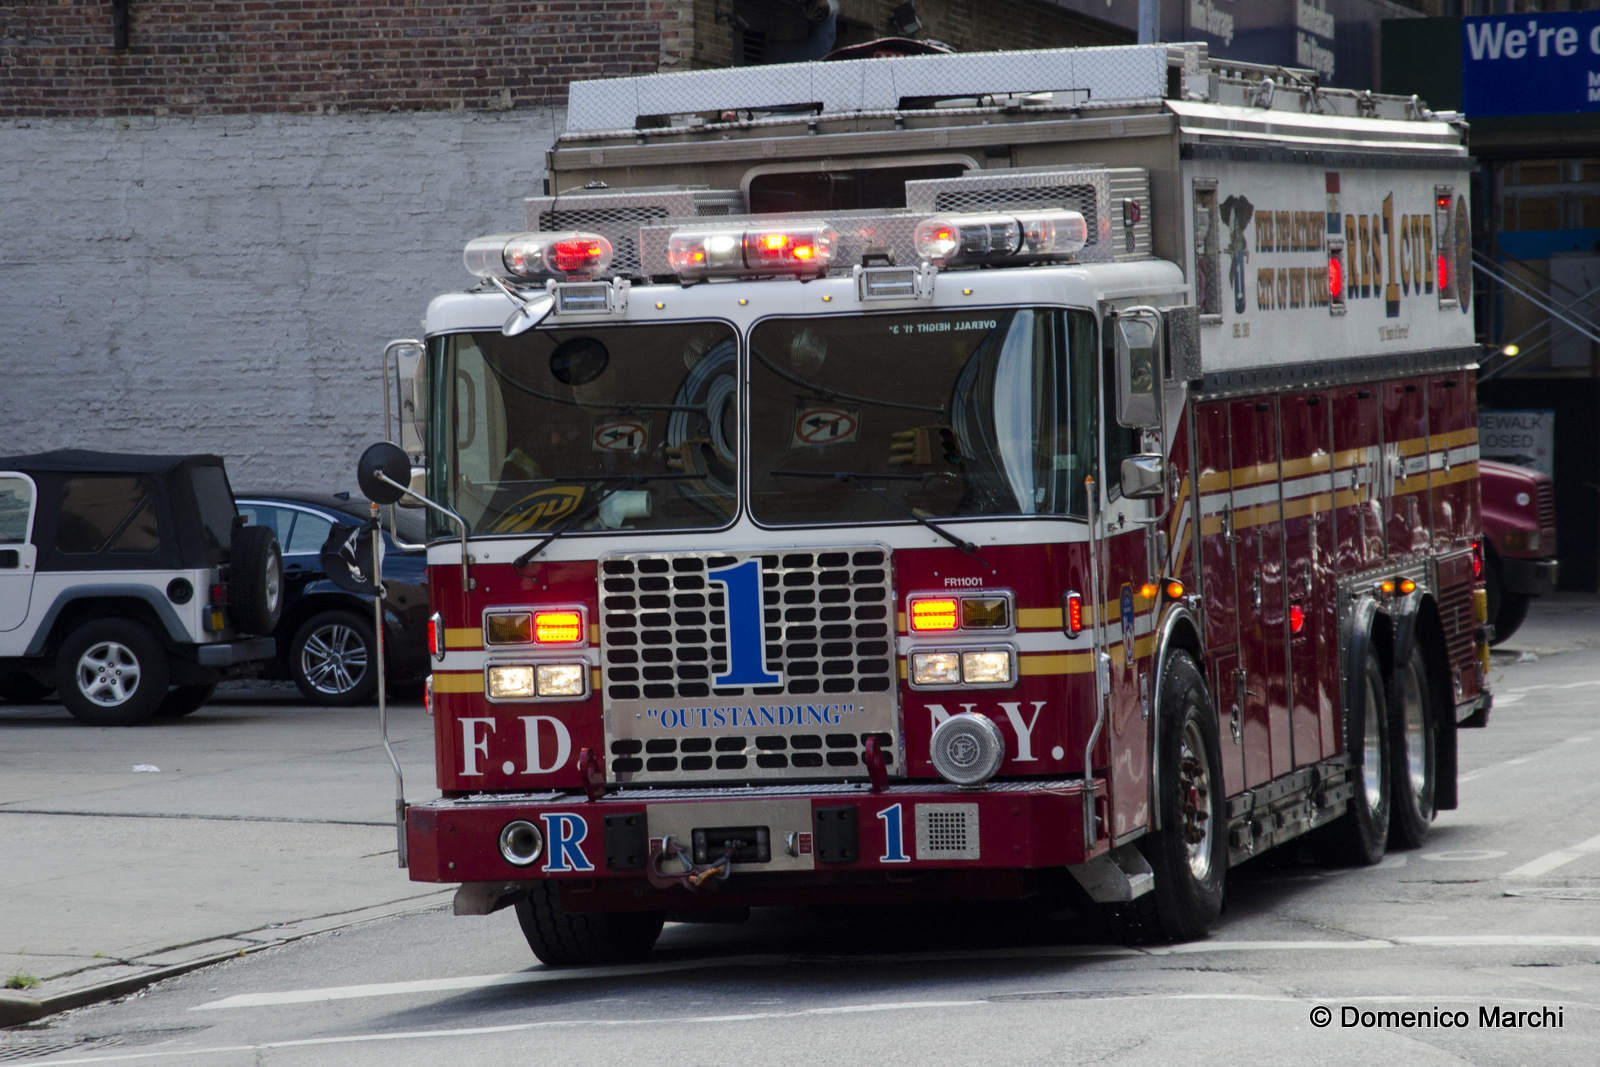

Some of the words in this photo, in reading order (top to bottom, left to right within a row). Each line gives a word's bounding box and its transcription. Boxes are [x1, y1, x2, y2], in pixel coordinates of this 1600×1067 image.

[1466, 21, 1579, 60] We're
[1255, 210, 1274, 252] FIRE
[1275, 210, 1326, 252] DEPARTMENT
[1257, 267, 1275, 311] CITY
[1277, 267, 1288, 310] OF
[1307, 266, 1330, 308] YORK
[1478, 415, 1543, 430] DEWALK
[944, 577, 983, 587] FR11001
[706, 556, 784, 688] 1
[647, 704, 854, 729] "OUTSTANDING"
[457, 715, 581, 776] F.D
[540, 812, 595, 872] R
[876, 803, 911, 863] 1
